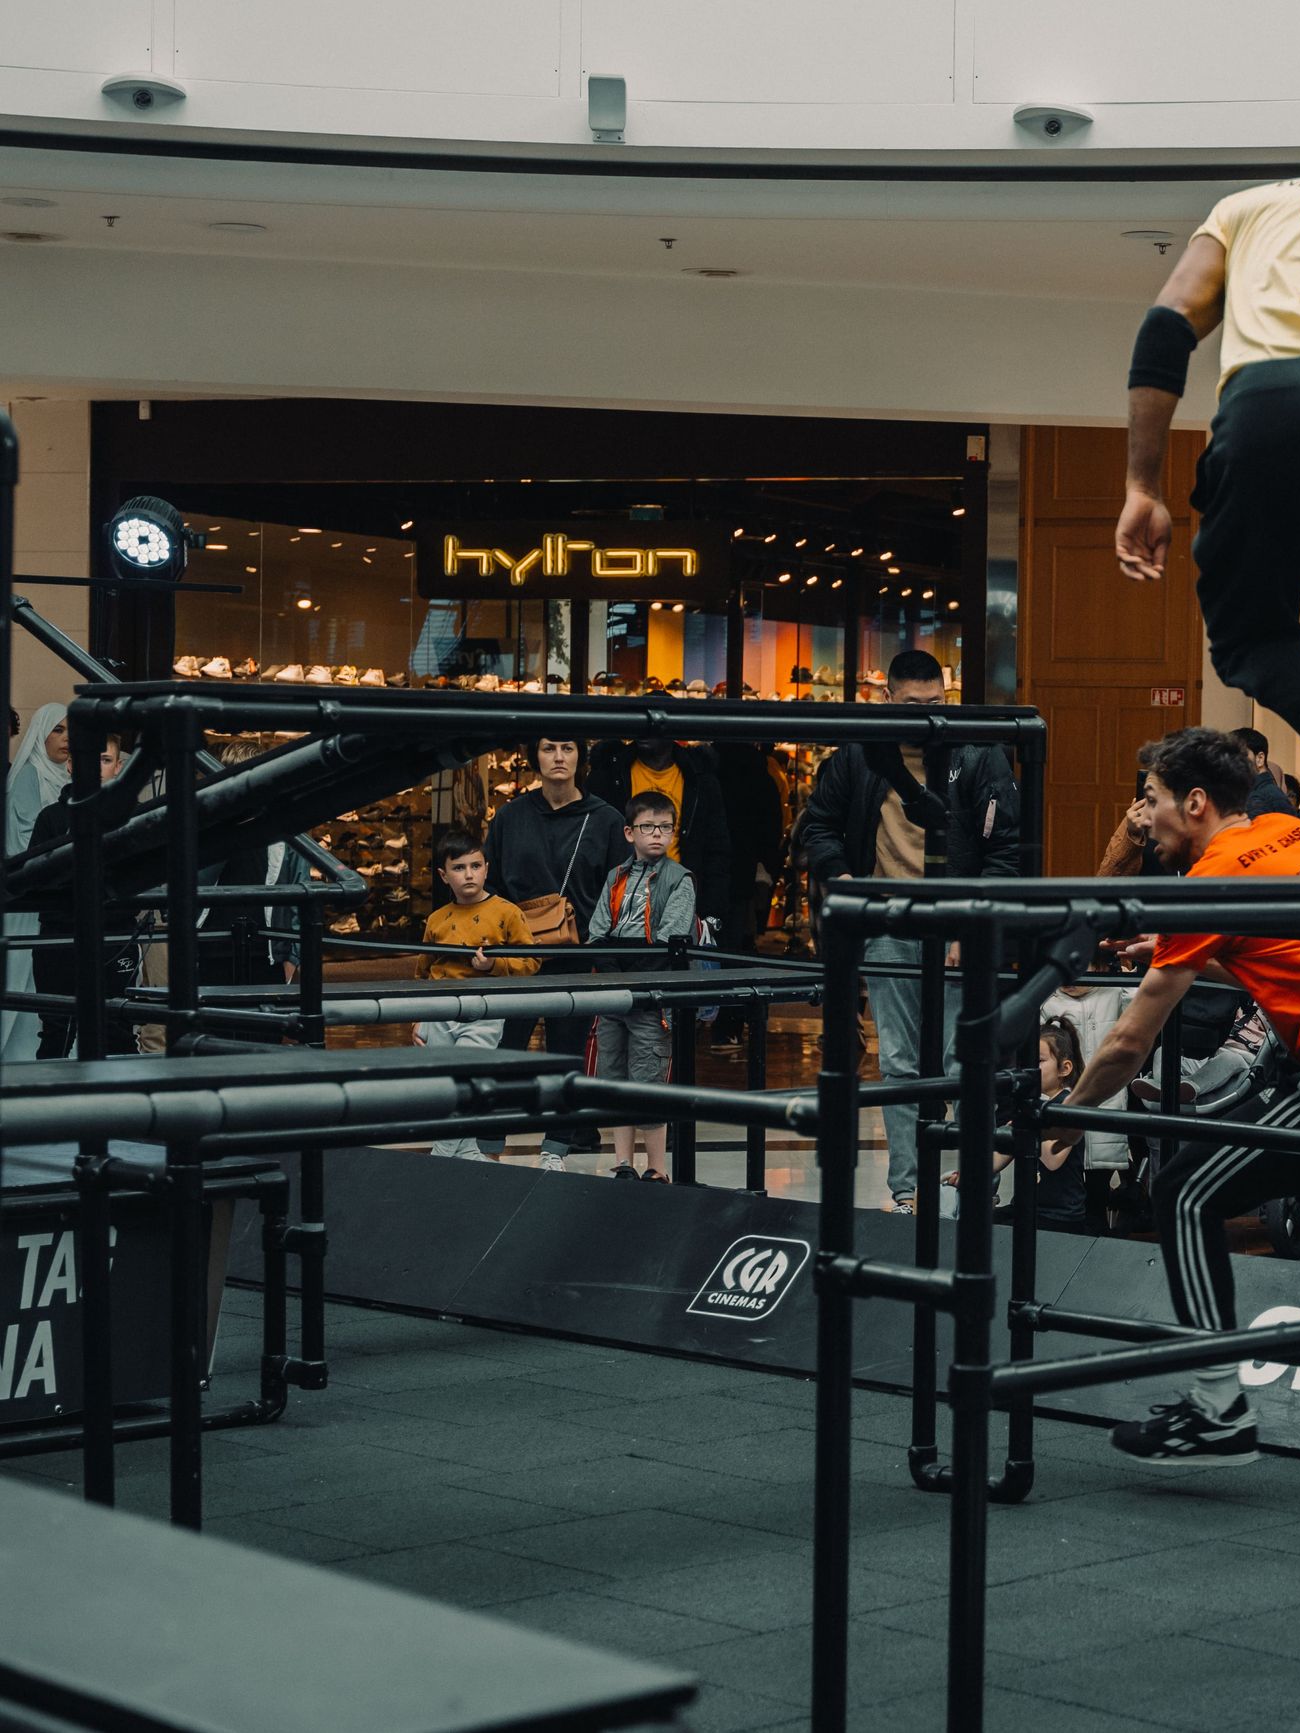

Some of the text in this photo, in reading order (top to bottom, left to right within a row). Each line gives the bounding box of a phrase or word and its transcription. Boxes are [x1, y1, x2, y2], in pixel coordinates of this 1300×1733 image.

[1237, 848, 1267, 868] EVRY
[723, 1247, 788, 1294] CGR
[708, 1292, 767, 1309] CINEMAS
